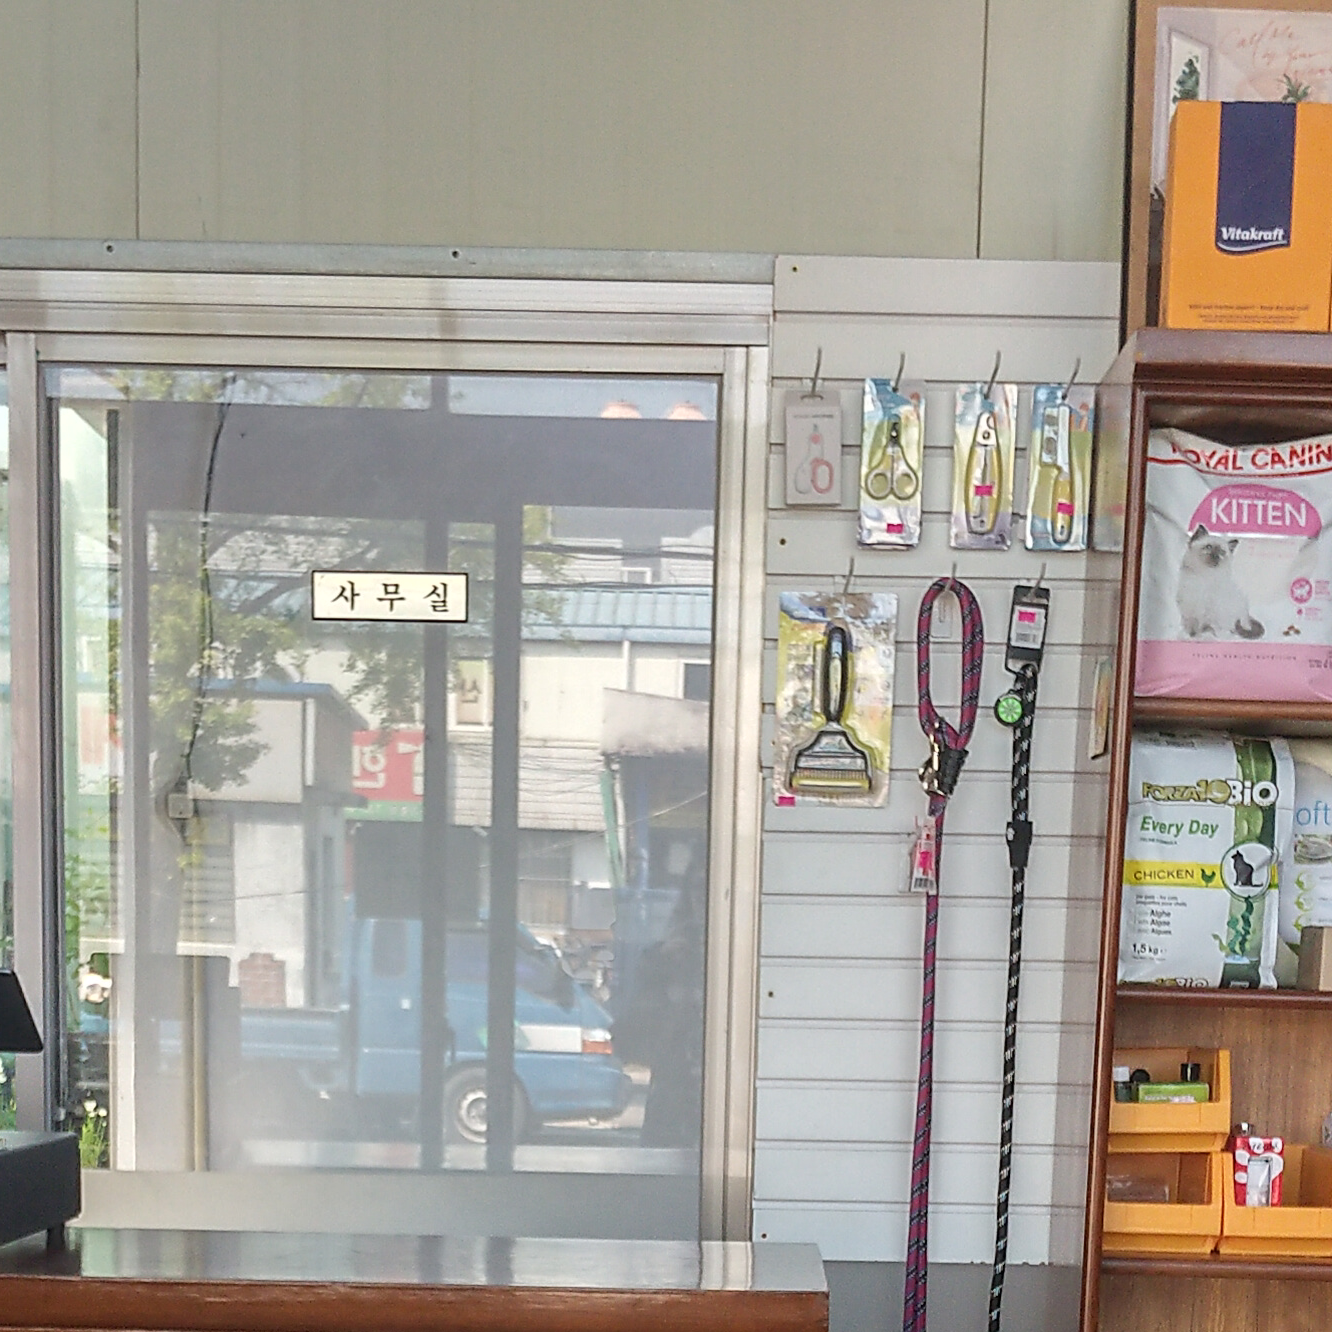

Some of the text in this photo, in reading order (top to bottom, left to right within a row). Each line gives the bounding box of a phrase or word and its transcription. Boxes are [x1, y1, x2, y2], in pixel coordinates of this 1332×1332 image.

[1220, 226, 1285, 242] Vitakraft
[1210, 497, 1307, 527] KITTEN
[331, 580, 449, 612] 사무실
[1140, 815, 1220, 838] Every Day
[1133, 868, 1195, 881] CHICKEN
